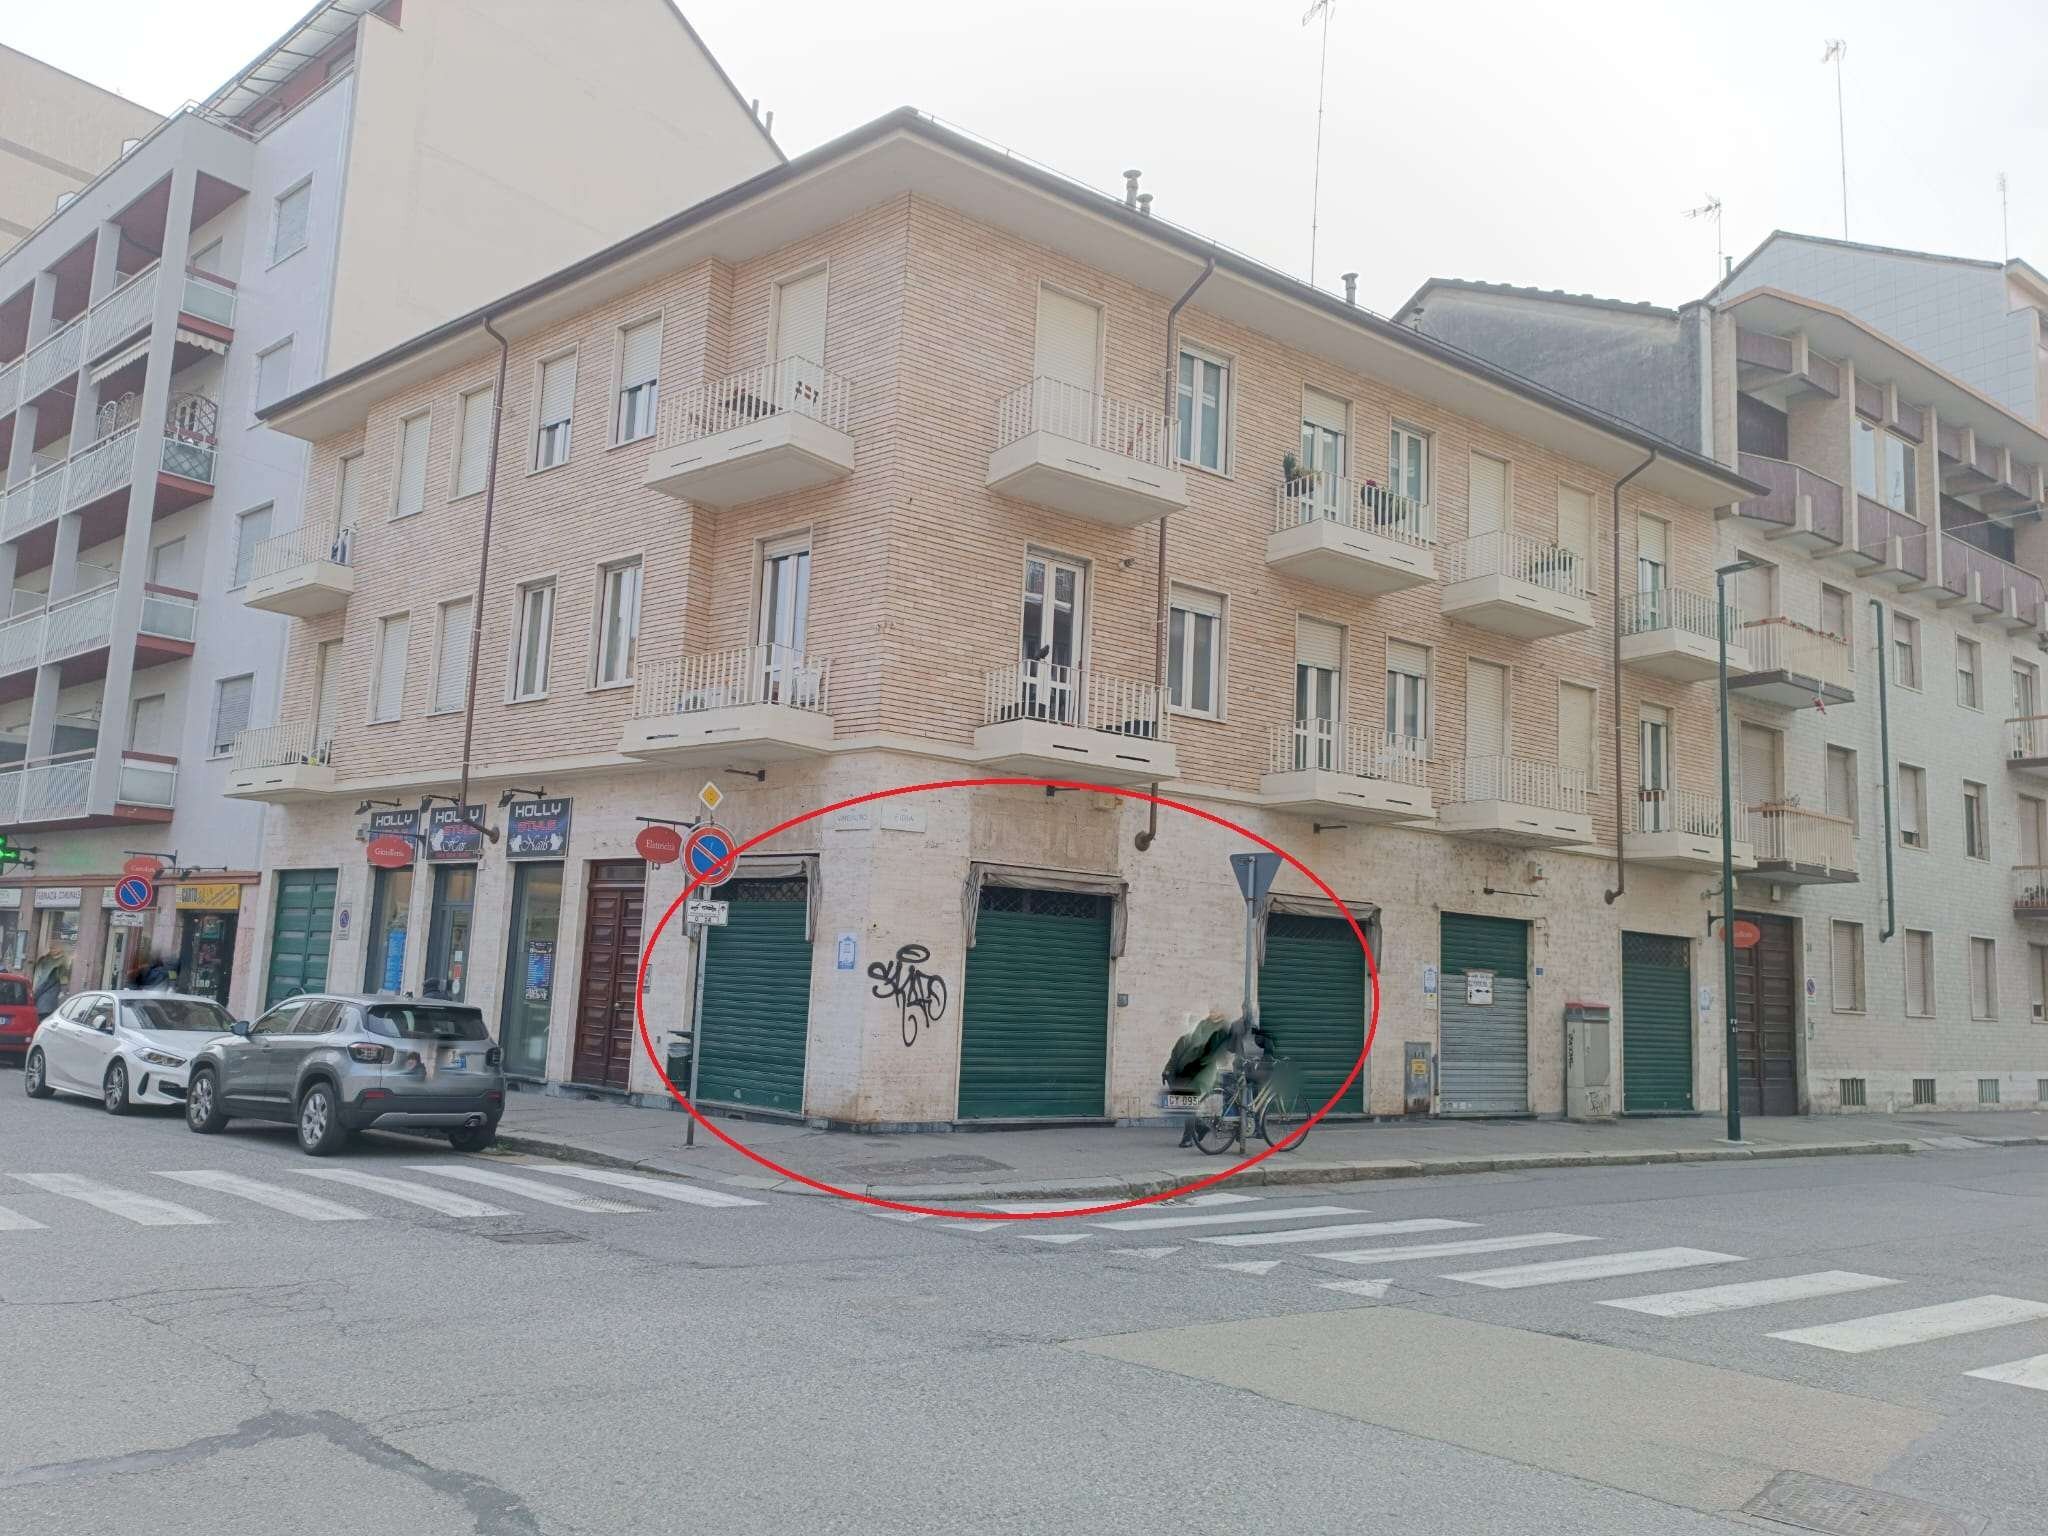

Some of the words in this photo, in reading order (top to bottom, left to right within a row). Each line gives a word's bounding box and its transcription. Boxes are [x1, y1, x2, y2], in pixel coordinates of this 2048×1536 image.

[435, 808, 479, 823] HOLY
[515, 803, 561, 817] HOLLY
[376, 813, 413, 827] HOLLY
